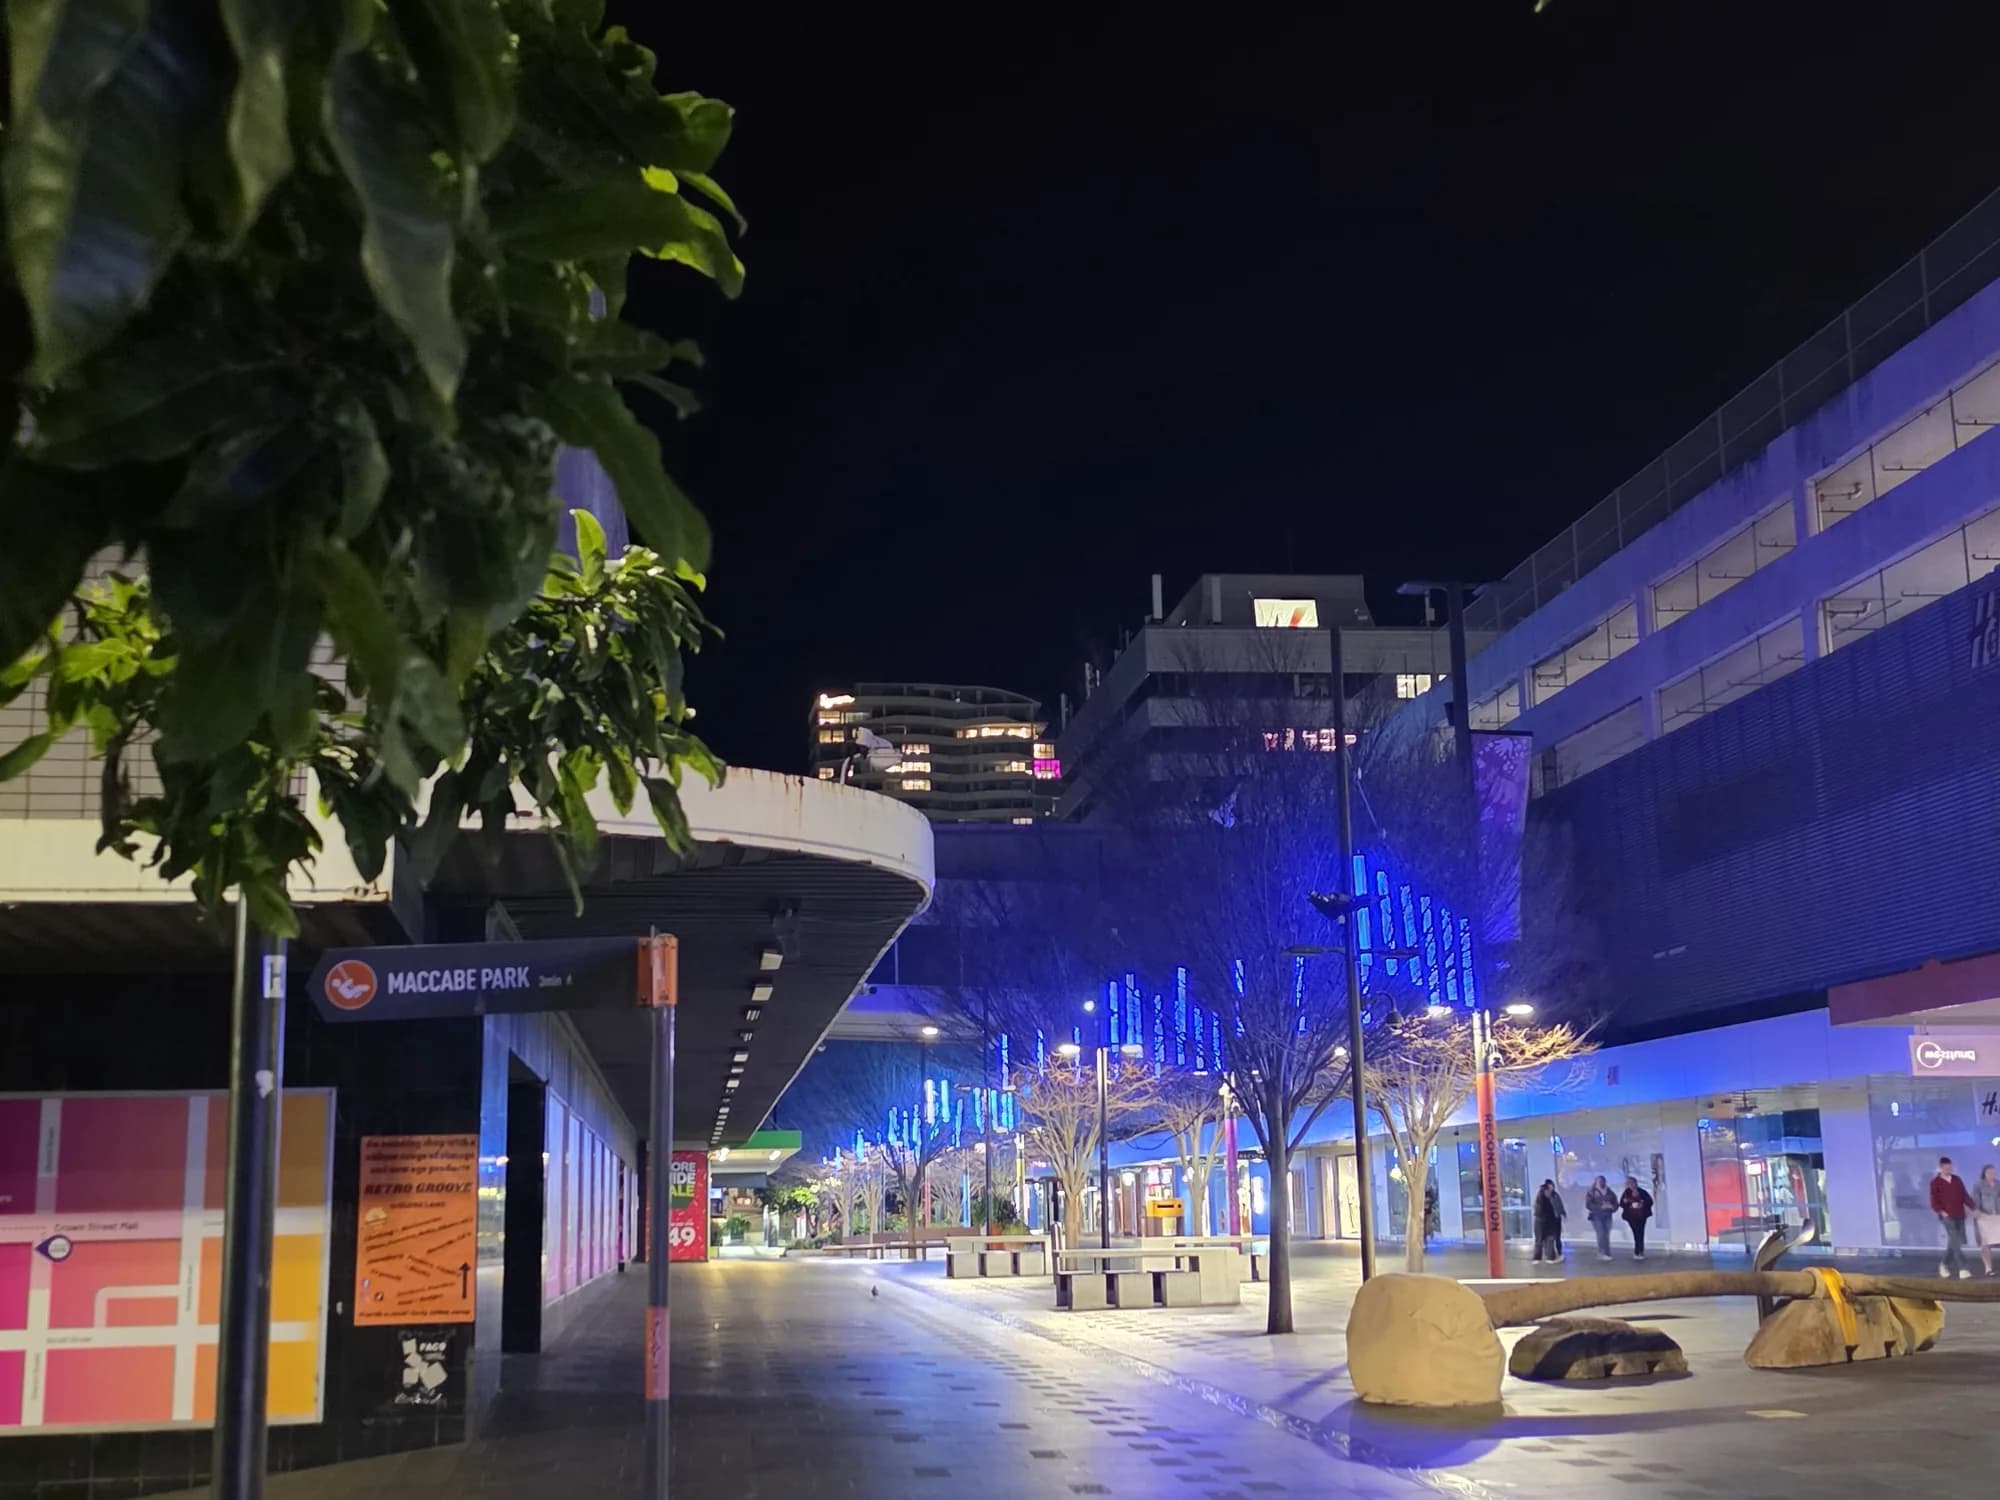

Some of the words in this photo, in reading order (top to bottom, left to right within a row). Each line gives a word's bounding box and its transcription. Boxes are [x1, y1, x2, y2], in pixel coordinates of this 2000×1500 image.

[388, 969, 476, 994] MACCABE
[481, 966, 529, 989] PARK
[670, 1161, 696, 1172] ORE
[1483, 1113, 1501, 1232] RECONCILIATION
[364, 1183, 413, 1195] RETRO
[416, 1182, 473, 1194] GROOVE
[669, 1184, 695, 1197] ALE
